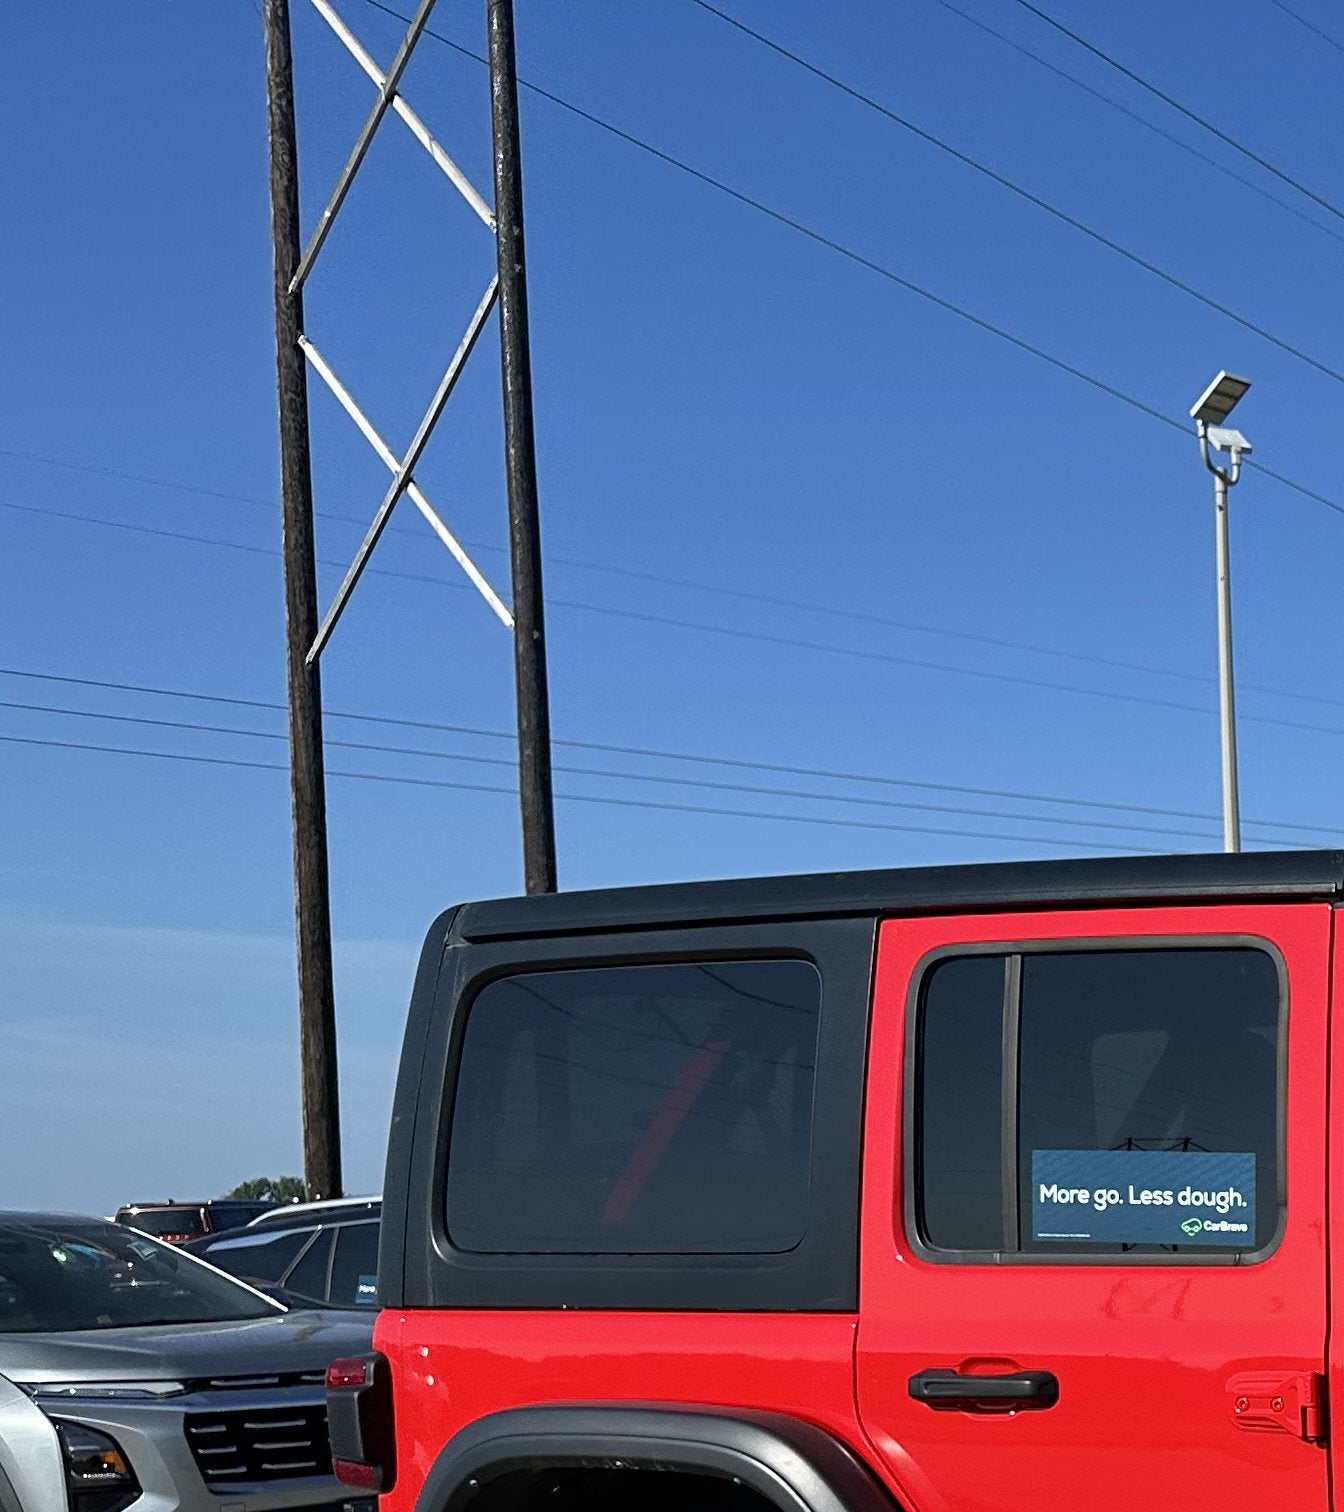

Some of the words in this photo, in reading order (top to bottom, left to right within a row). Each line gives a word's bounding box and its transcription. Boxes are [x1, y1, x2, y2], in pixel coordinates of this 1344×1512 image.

[1040, 1184, 1090, 1204] More
[1094, 1188, 1124, 1211] go.
[1129, 1185, 1174, 1205] Less
[1177, 1186, 1247, 1213] dough.
